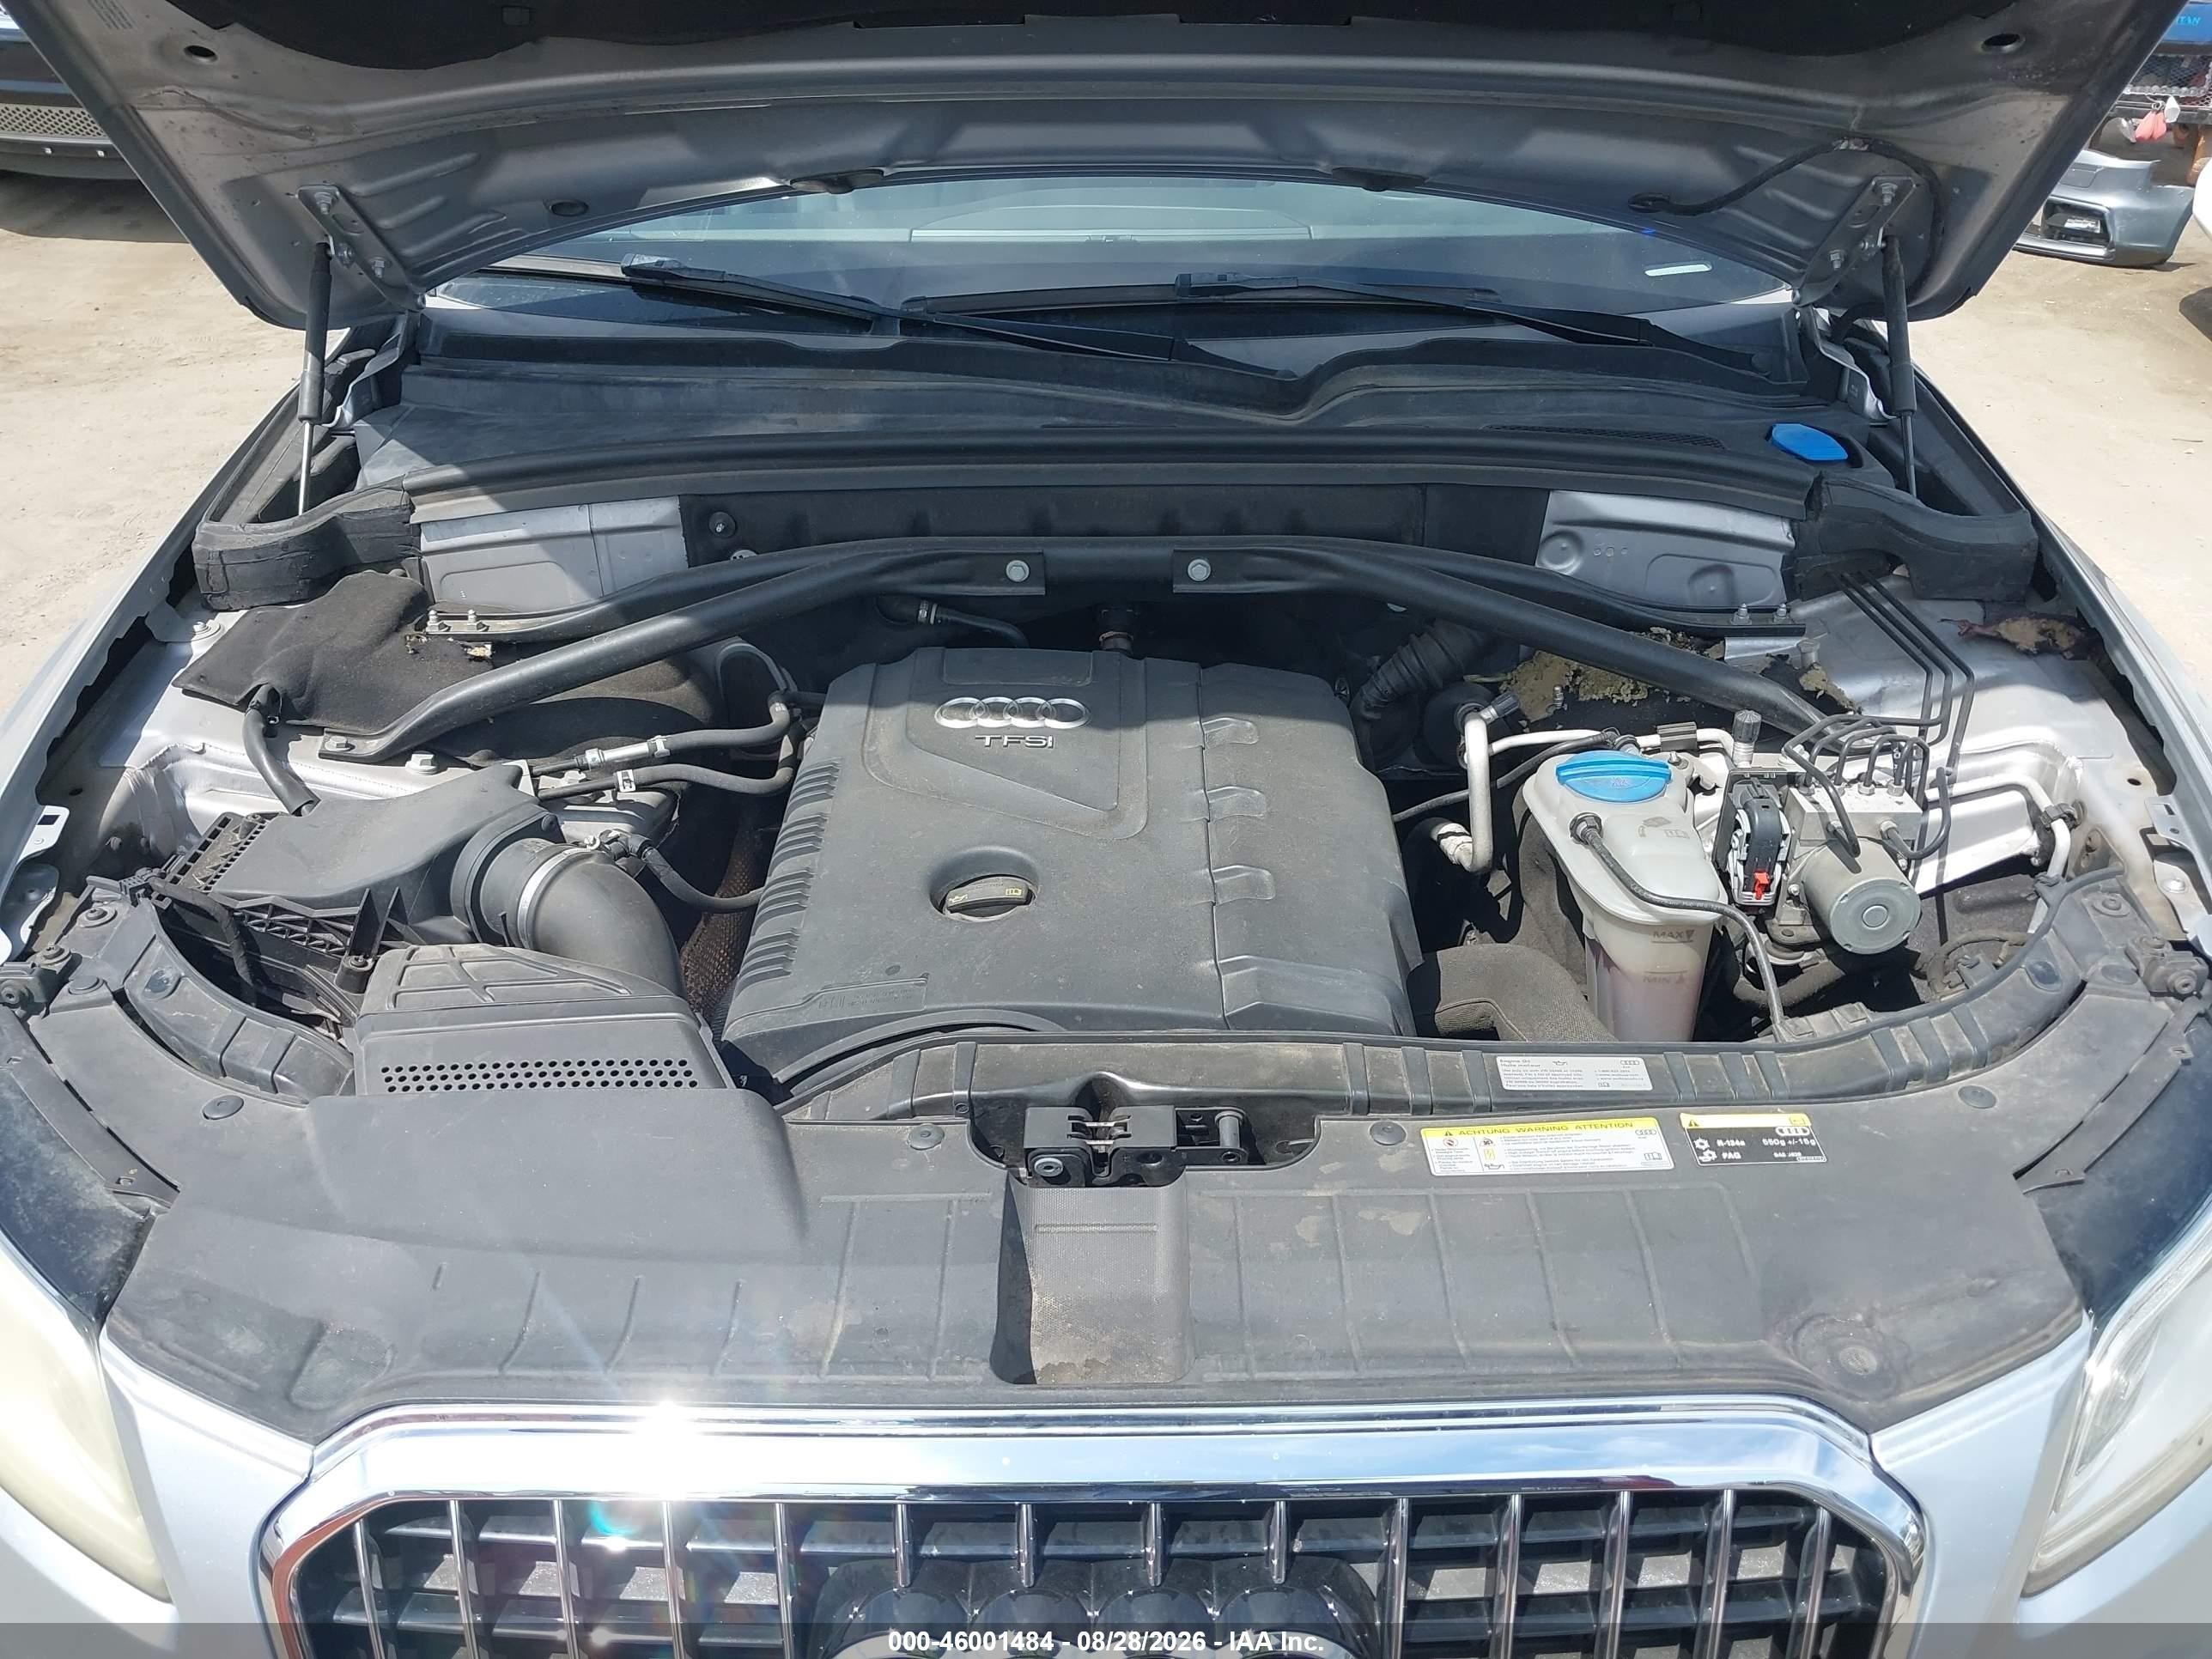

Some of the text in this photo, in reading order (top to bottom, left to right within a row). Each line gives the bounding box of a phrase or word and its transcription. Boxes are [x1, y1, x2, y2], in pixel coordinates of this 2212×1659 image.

[975, 735, 1055, 749] TFSI
[1458, 1121, 1633, 1137] ACHTUNG WARNING ATTENTION
[1721, 1152, 1741, 1160] PAG
